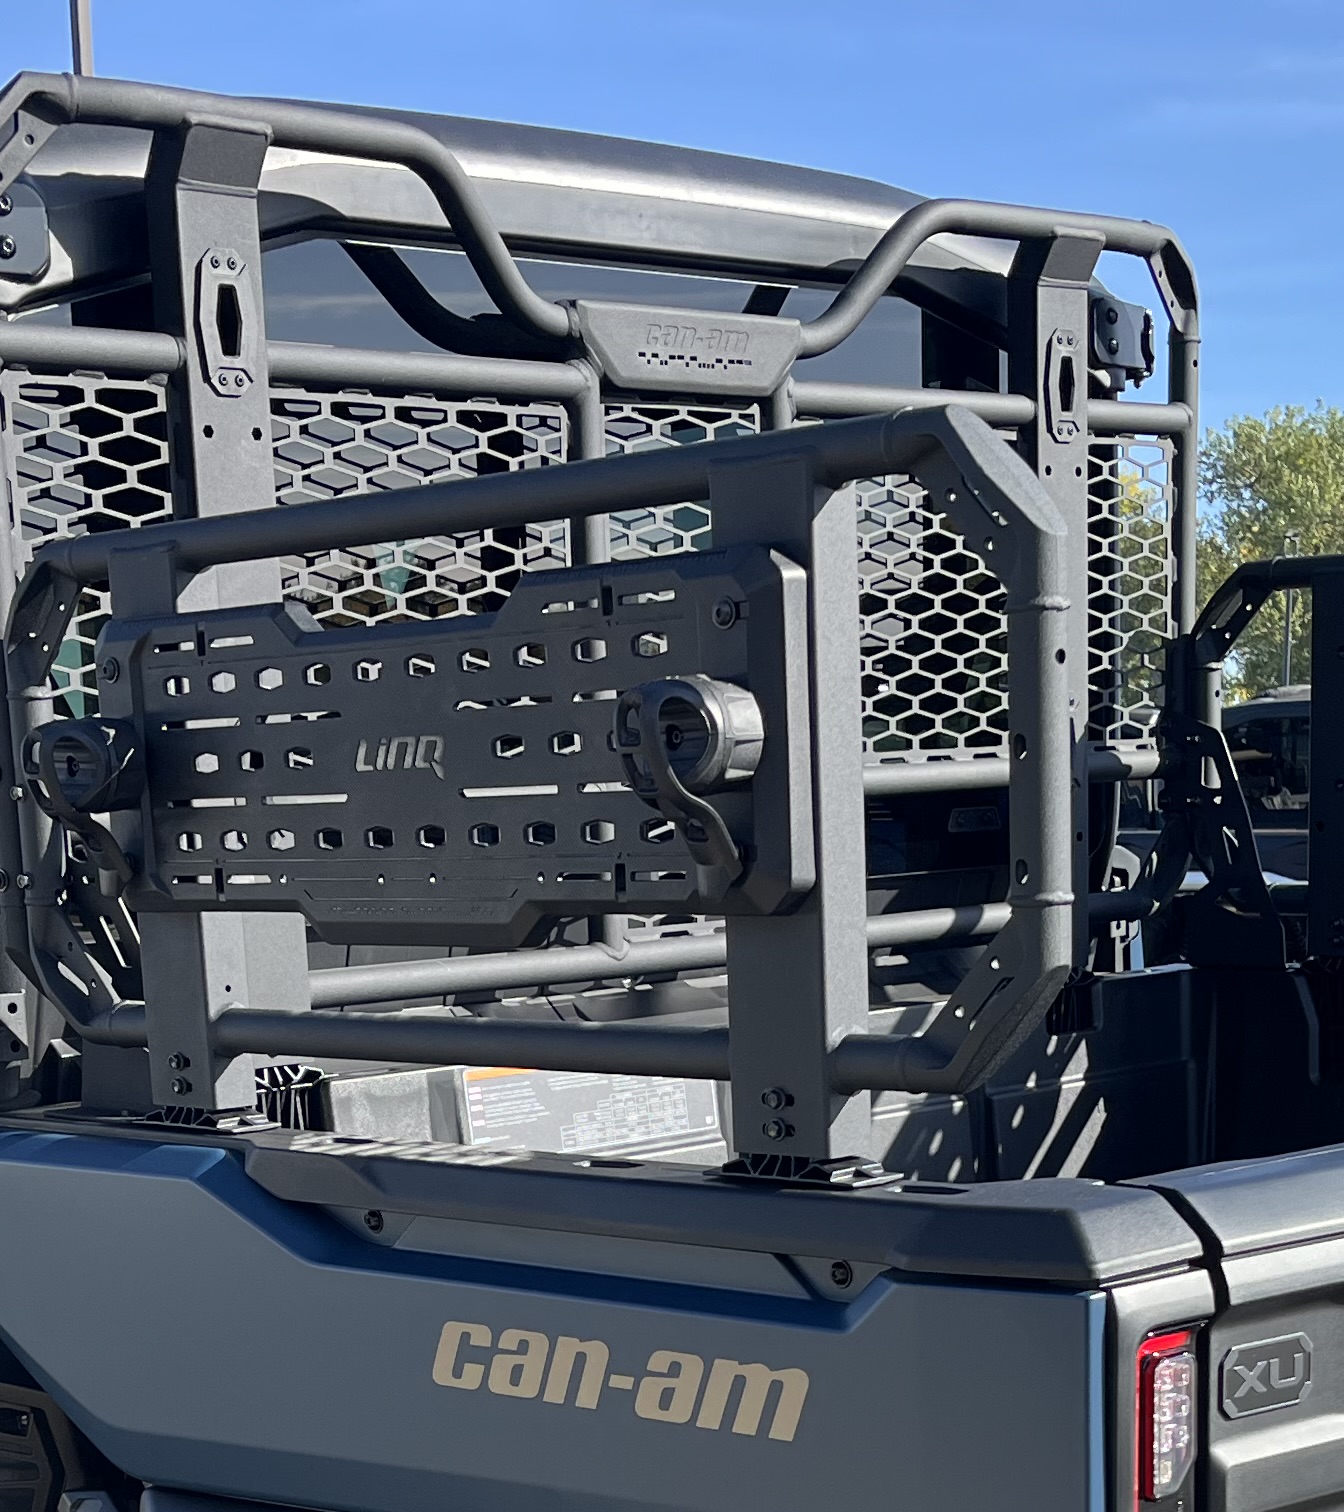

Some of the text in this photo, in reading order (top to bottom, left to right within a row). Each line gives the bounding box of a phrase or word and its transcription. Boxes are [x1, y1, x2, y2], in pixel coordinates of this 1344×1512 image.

[646, 323, 750, 354] can-am
[431, 1319, 811, 1442] can-am
[1233, 1352, 1304, 1398] XU
